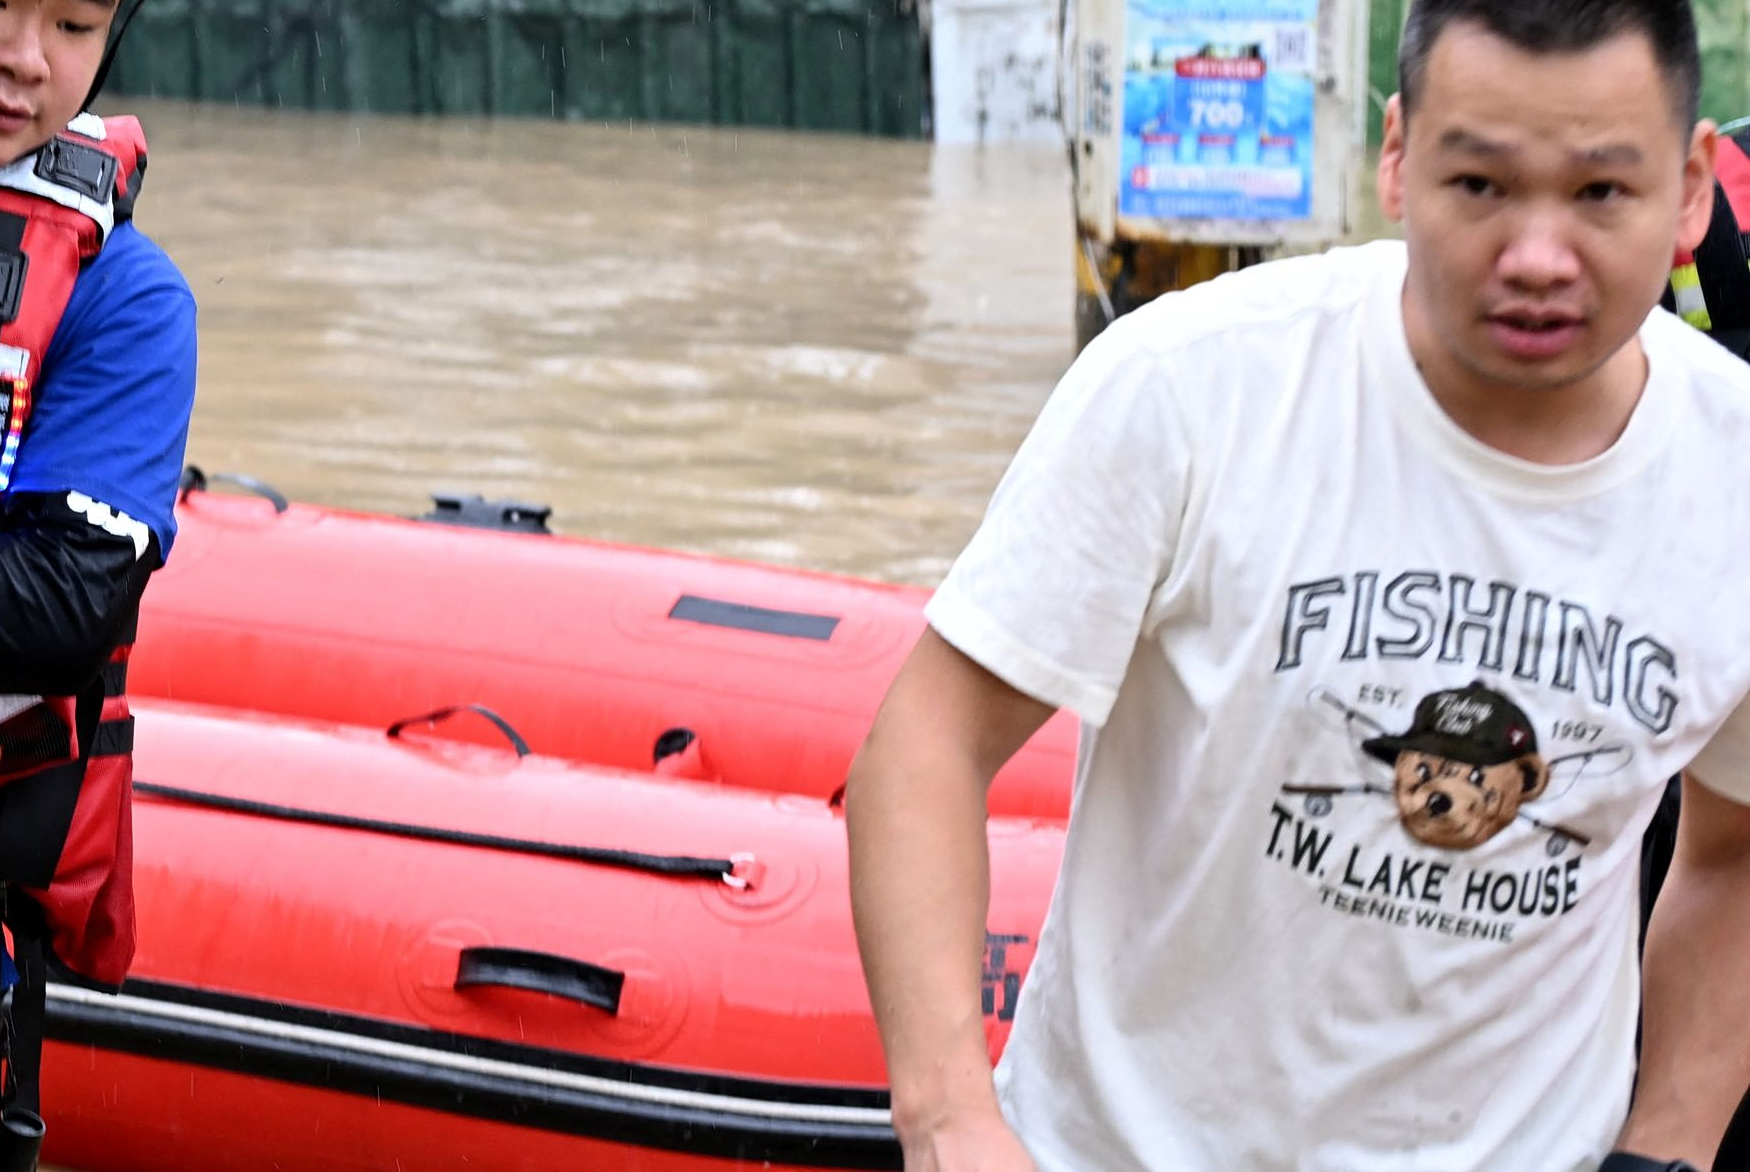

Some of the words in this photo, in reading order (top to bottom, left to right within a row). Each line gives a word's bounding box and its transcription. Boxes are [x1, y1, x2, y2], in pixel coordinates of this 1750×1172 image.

[1190, 100, 1245, 127] 700
[1274, 570, 1680, 735] FISHING
[1265, 800, 1333, 879] T.W.
[1342, 843, 1451, 904] LAKE
[1461, 854, 1581, 917] HOUSE
